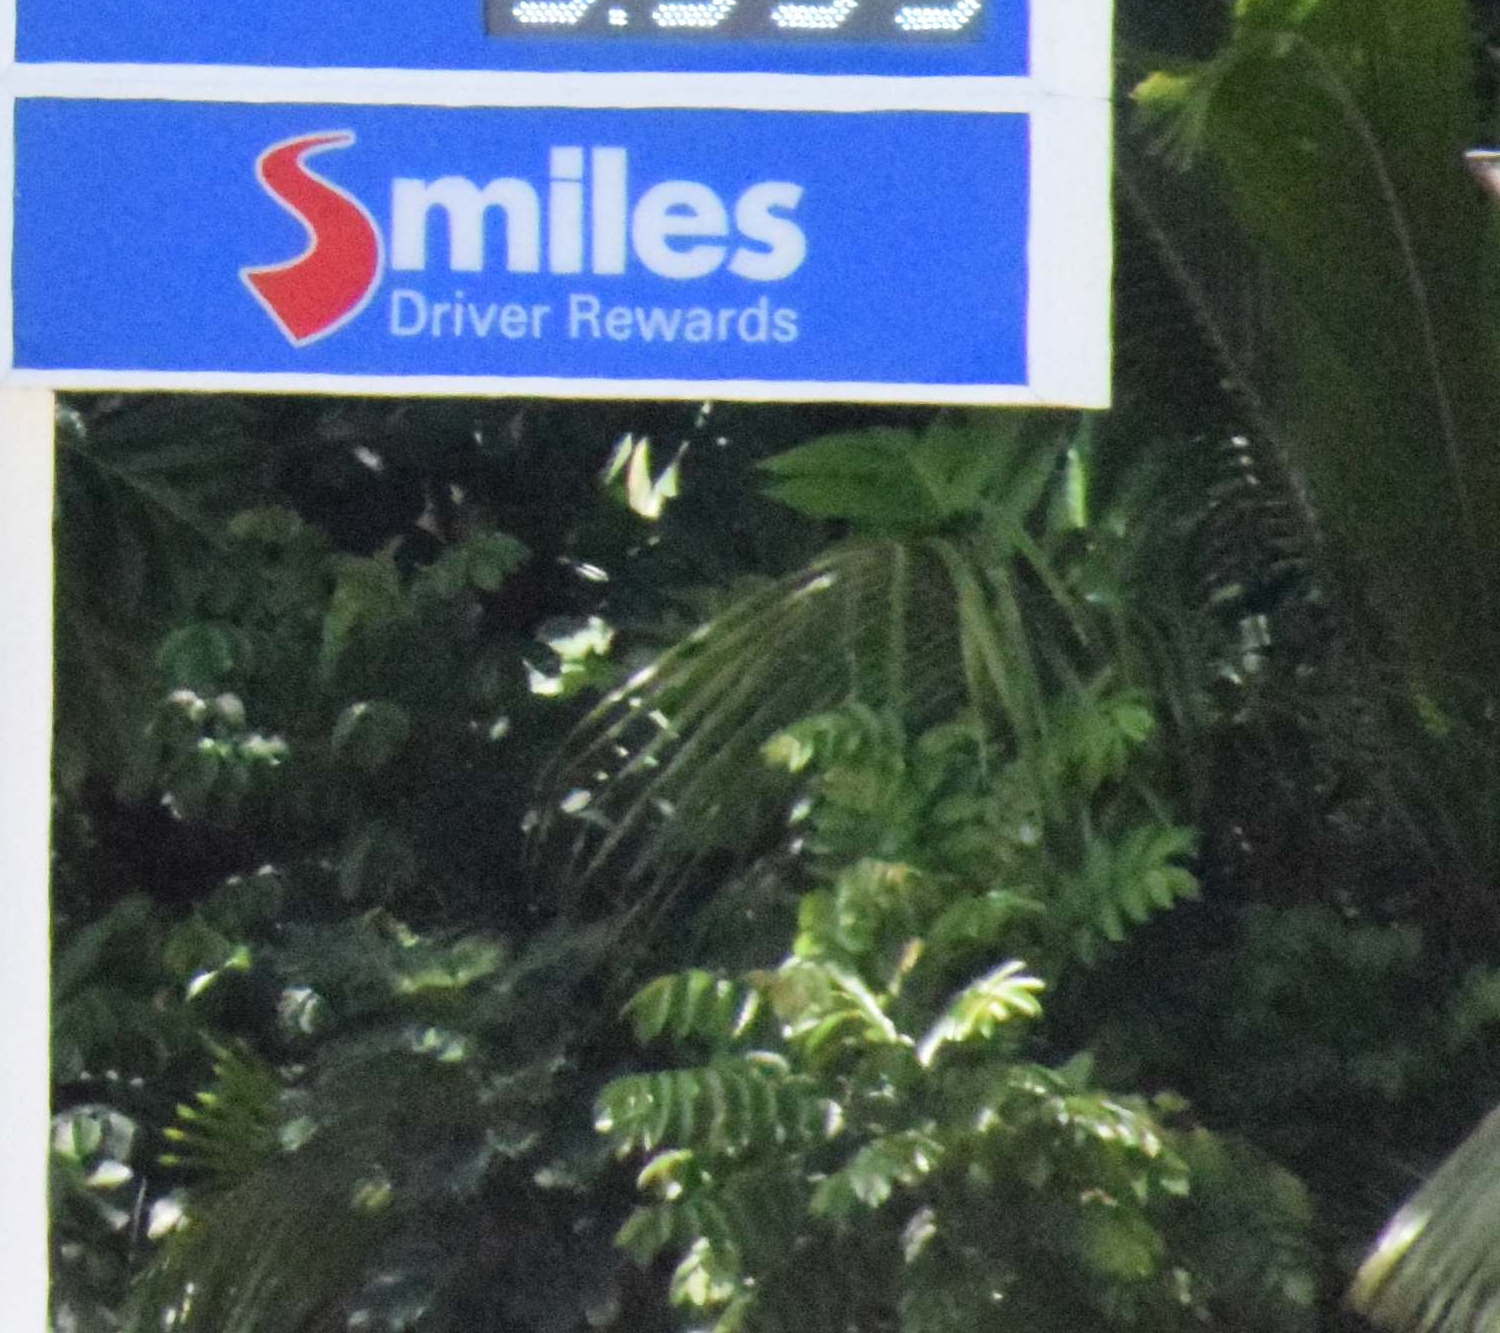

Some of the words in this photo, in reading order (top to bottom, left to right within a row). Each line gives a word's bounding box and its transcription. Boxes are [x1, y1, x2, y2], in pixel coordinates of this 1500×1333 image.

[240, 130, 807, 348] Smiles
[390, 290, 548, 338] Driver
[569, 294, 798, 342] Rewards
